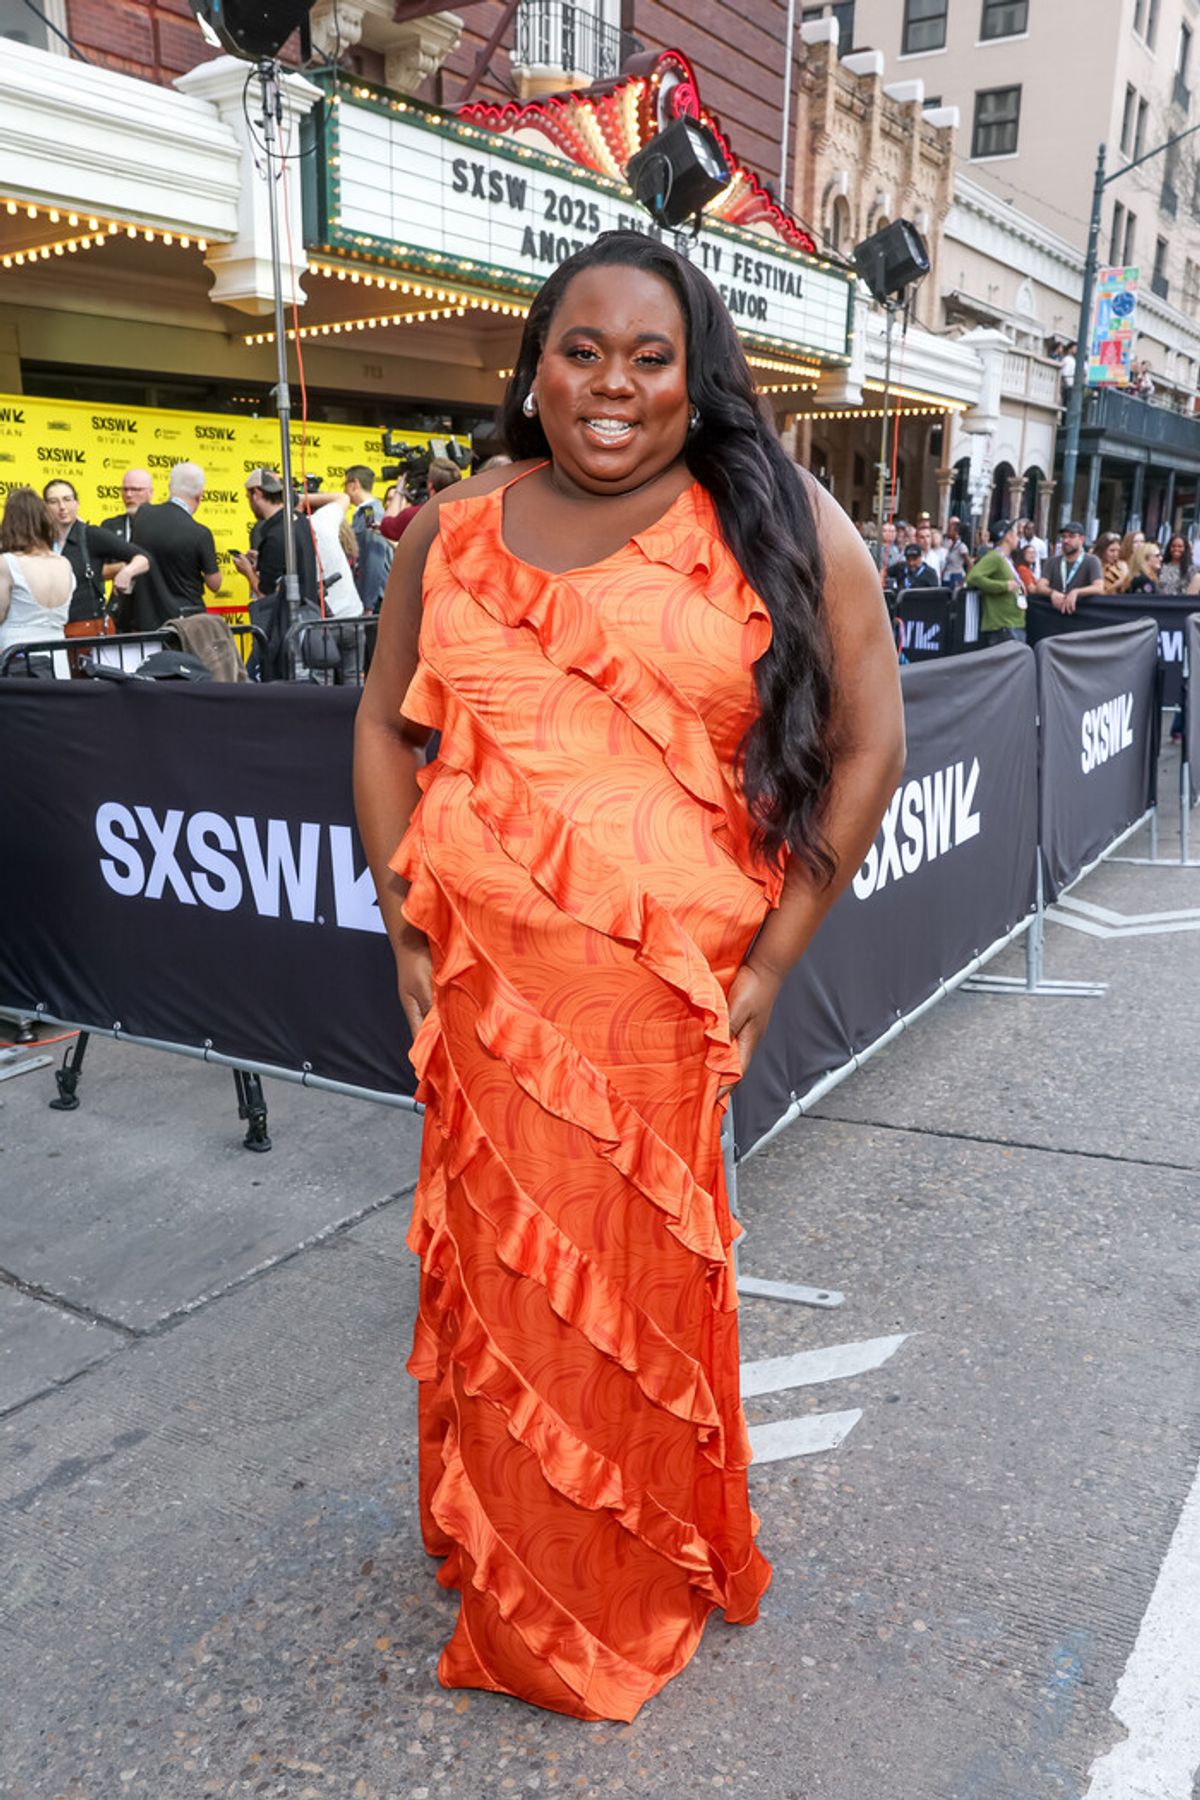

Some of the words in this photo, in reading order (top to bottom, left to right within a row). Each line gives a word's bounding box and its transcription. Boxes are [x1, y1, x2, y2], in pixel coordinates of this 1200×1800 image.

[452, 158, 527, 211] SXSW
[543, 188, 600, 233] 2025
[701, 241, 722, 272] TV
[733, 253, 803, 299] FESTIVAL
[520, 225, 590, 267] ANOT
[91, 416, 126, 432] SXSW
[195, 425, 226, 440] SXSW
[37, 447, 74, 462] SXSW
[96, 485, 120, 499] SXS
[1081, 696, 1121, 775] SXSW
[95, 801, 320, 924] SXSW
